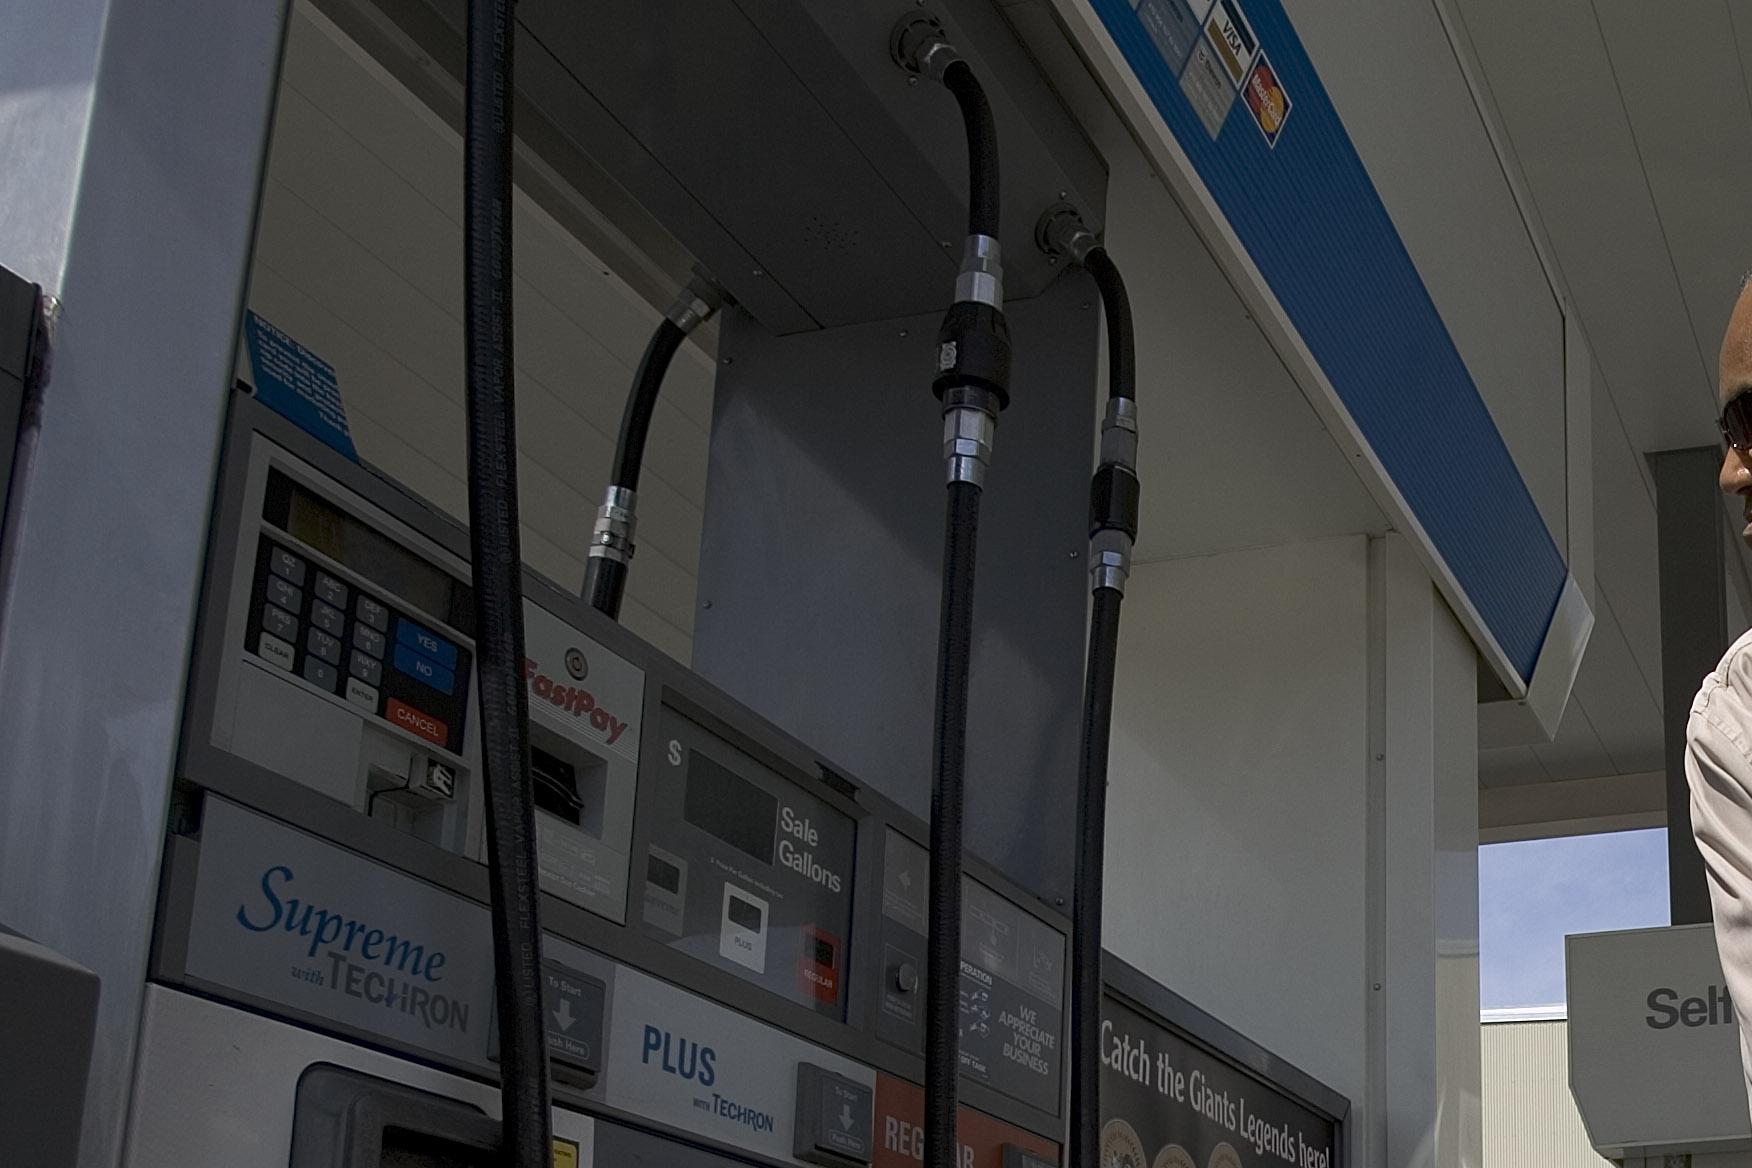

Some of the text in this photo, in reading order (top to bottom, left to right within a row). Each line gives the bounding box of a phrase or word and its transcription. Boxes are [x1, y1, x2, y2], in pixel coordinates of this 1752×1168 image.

[1223, 20, 1241, 57] VISA
[416, 632, 439, 654] YES
[416, 660, 433, 678] NO
[396, 706, 441, 738] CANCEL
[667, 738, 683, 768] $
[780, 805, 819, 848] Sale
[778, 839, 842, 894] Gallons
[236, 865, 447, 984] Supreme
[291, 949, 470, 1033] with TECHRON
[998, 1009, 1056, 1050] APPRECIATE
[1019, 1004, 1038, 1025] WE
[642, 1023, 717, 1087] PLUS
[1002, 1041, 1050, 1077] BUSINESS
[1011, 1030, 1042, 1058] YOUR
[1101, 1019, 1150, 1087] Catch
[1156, 1052, 1186, 1103] the
[1189, 1069, 1237, 1132] Giants
[1239, 1097, 1296, 1164] Legends
[711, 1092, 775, 1133] TECHRON
